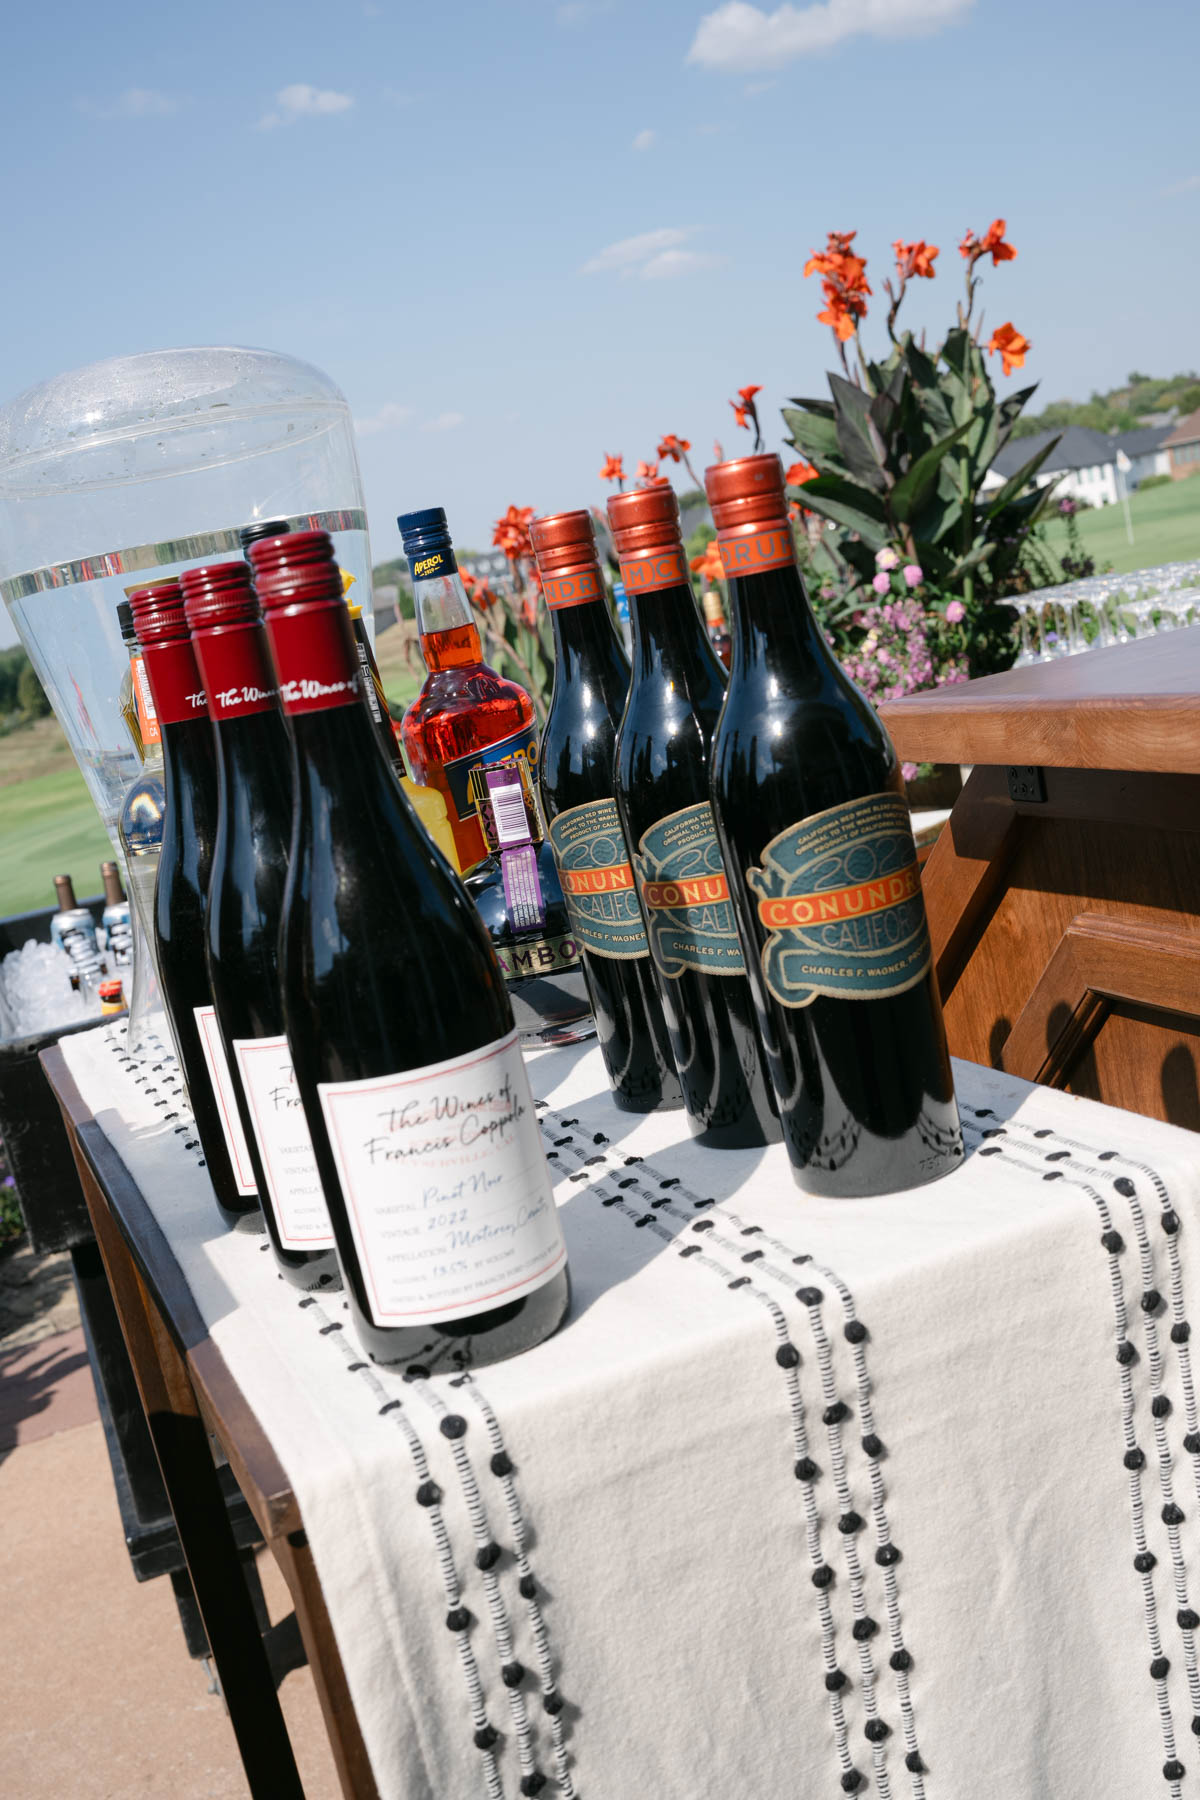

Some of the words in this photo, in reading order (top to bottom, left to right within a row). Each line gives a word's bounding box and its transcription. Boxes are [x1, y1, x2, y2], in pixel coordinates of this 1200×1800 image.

[414, 553, 443, 576] APEROL
[215, 687, 242, 708] The
[280, 680, 300, 703] The
[300, 679, 345, 699] Wines
[570, 827, 592, 840] PRODUCT
[664, 816, 699, 837] CALIFORNIA
[677, 829, 707, 846] PRODUCT
[797, 818, 839, 844] CALIFORNIA
[840, 812, 855, 823] RED
[829, 828, 840, 837] TO
[841, 821, 856, 832] THE
[813, 833, 849, 854] PRODUCT
[849, 830, 859, 838] OF
[563, 868, 627, 891] ONUN
[576, 925, 603, 939] CHARLES
[673, 942, 714, 955] CHARLES
[717, 948, 724, 956] F.
[802, 965, 853, 977] CHARLES
[856, 969, 864, 977] F.
[377, 1100, 429, 1132] The
[431, 1092, 496, 1121] Wines
[499, 1073, 511, 1103] of
[364, 1136, 457, 1164] Francis
[423, 1180, 465, 1209] Pinot
[427, 1208, 468, 1231] 2022
